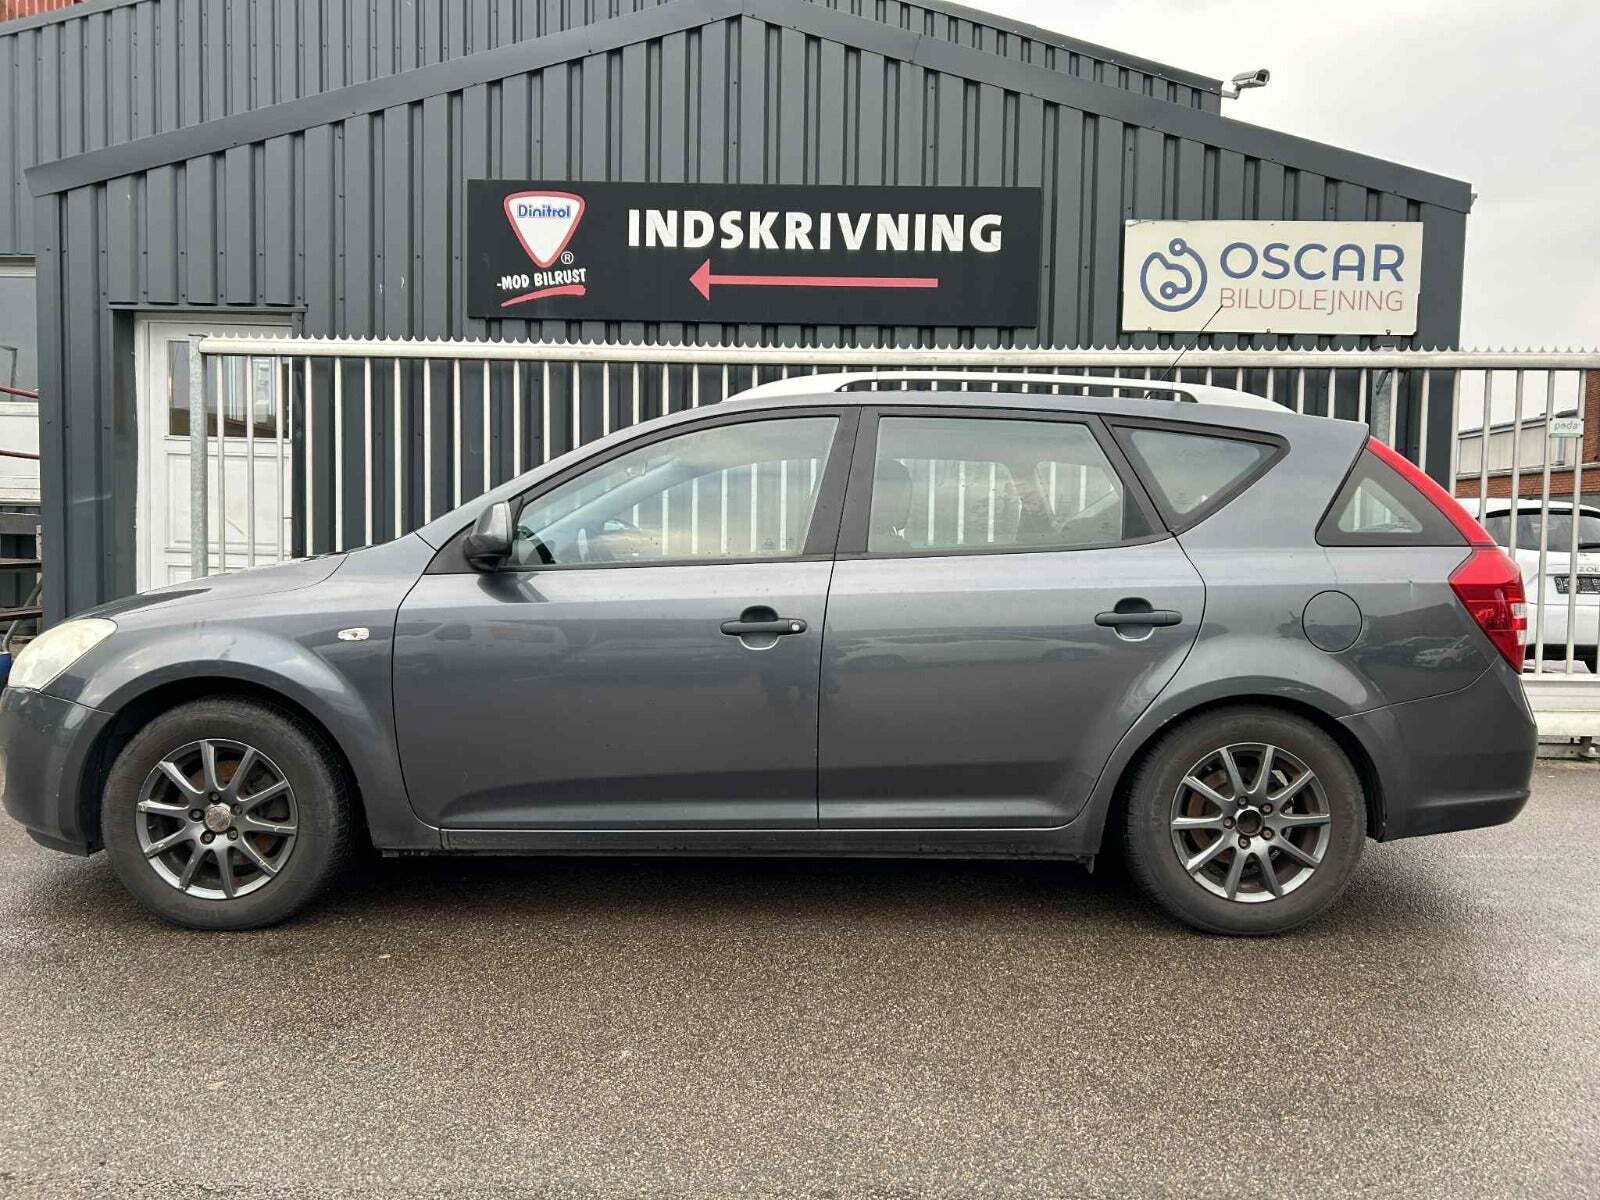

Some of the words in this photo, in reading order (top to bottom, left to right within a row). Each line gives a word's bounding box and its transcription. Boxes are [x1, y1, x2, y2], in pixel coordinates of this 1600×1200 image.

[518, 204, 571, 218] Dinitrol
[627, 208, 1003, 253] INDSKRIVNING
[1220, 242, 1405, 282] OSCAR
[496, 274, 530, 290] -MOD
[533, 268, 587, 287] BILRUST
[1220, 288, 1403, 315] BILUDLEJNING
